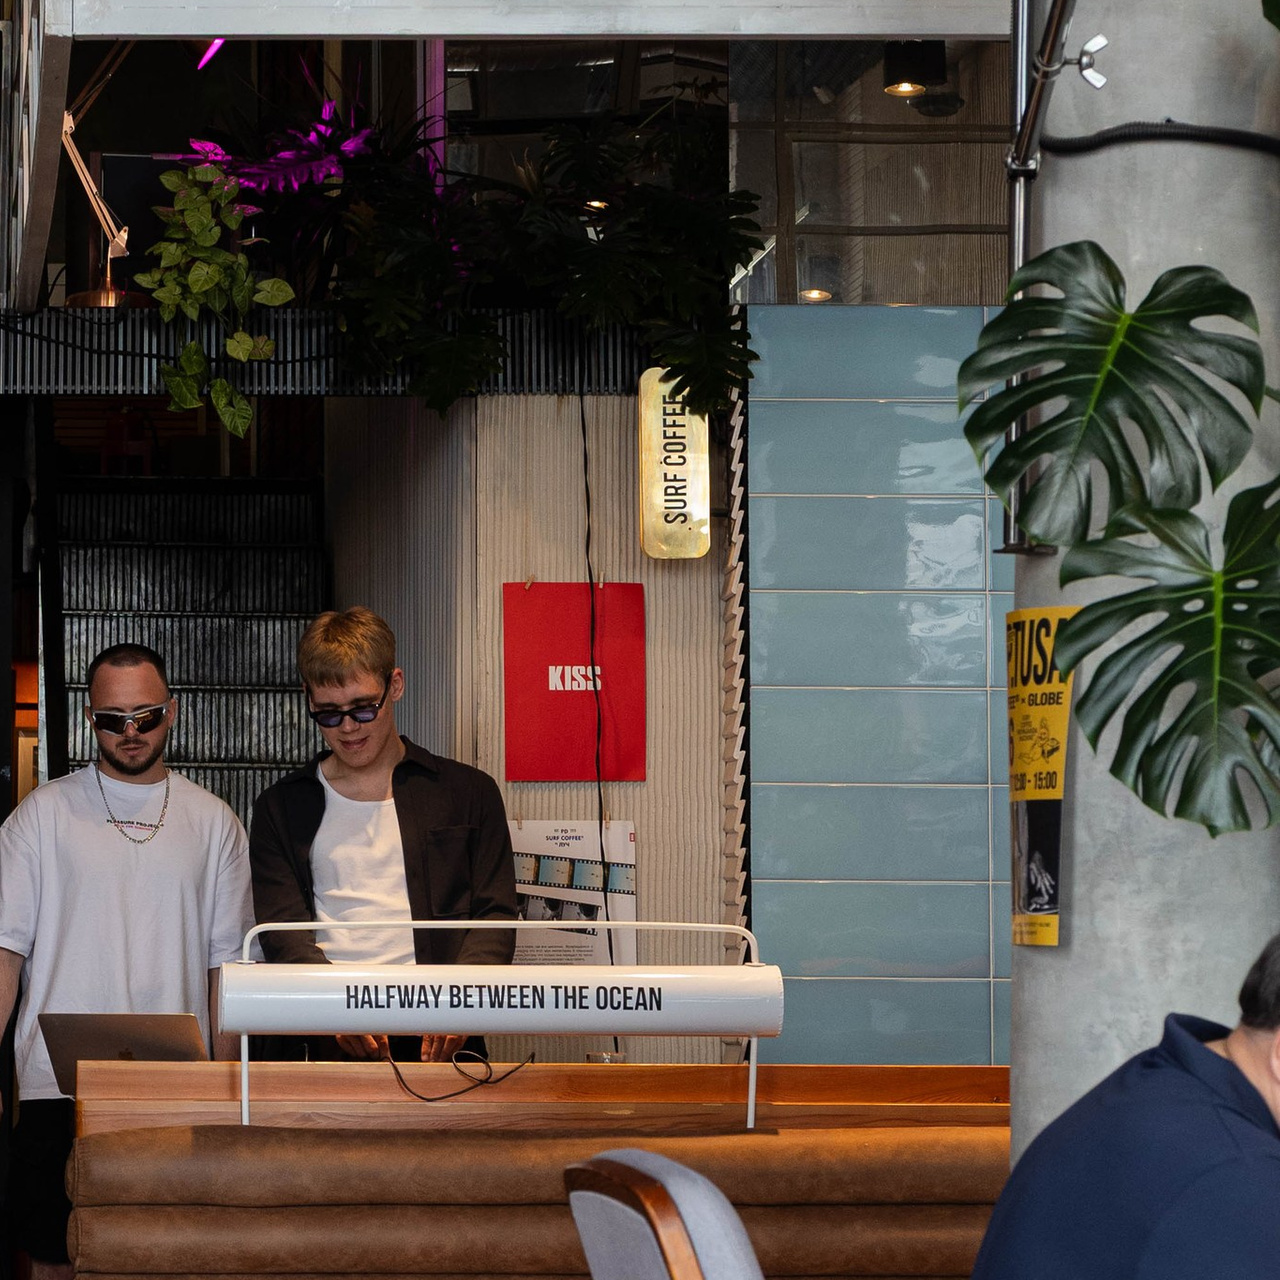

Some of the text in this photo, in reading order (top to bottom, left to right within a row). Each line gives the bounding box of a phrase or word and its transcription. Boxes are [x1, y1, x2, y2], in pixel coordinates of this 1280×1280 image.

[663, 394, 688, 524] SURF COFFEE
[548, 665, 601, 691] KISS
[1027, 692, 1064, 707] GLOBE
[1034, 770, 1058, 790] 15:00
[346, 984, 662, 1011] HALFWAY BETWEEN THE OCEAN
